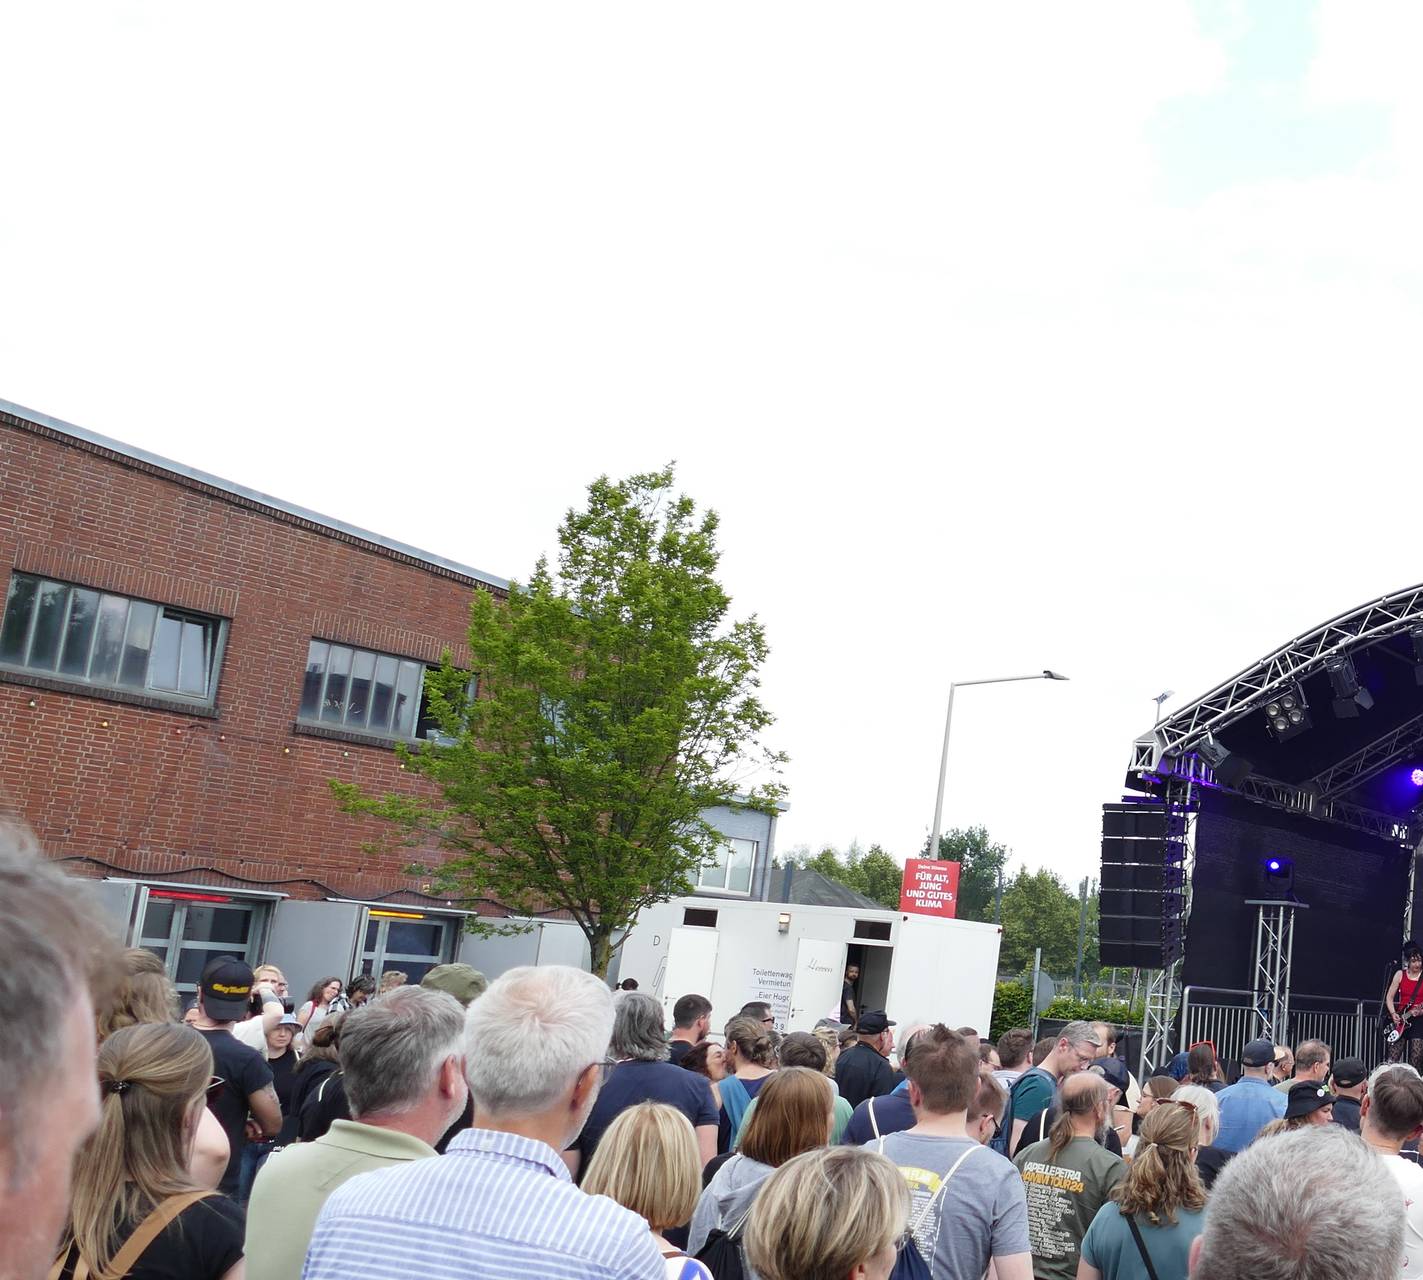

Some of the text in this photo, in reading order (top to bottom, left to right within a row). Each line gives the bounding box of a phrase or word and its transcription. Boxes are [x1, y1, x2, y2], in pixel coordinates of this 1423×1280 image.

[915, 871, 949, 884] FÜR ALT,
[919, 881, 942, 891] JUNG
[906, 889, 953, 900] UND GUTES
[915, 899, 943, 909] KLIMA
